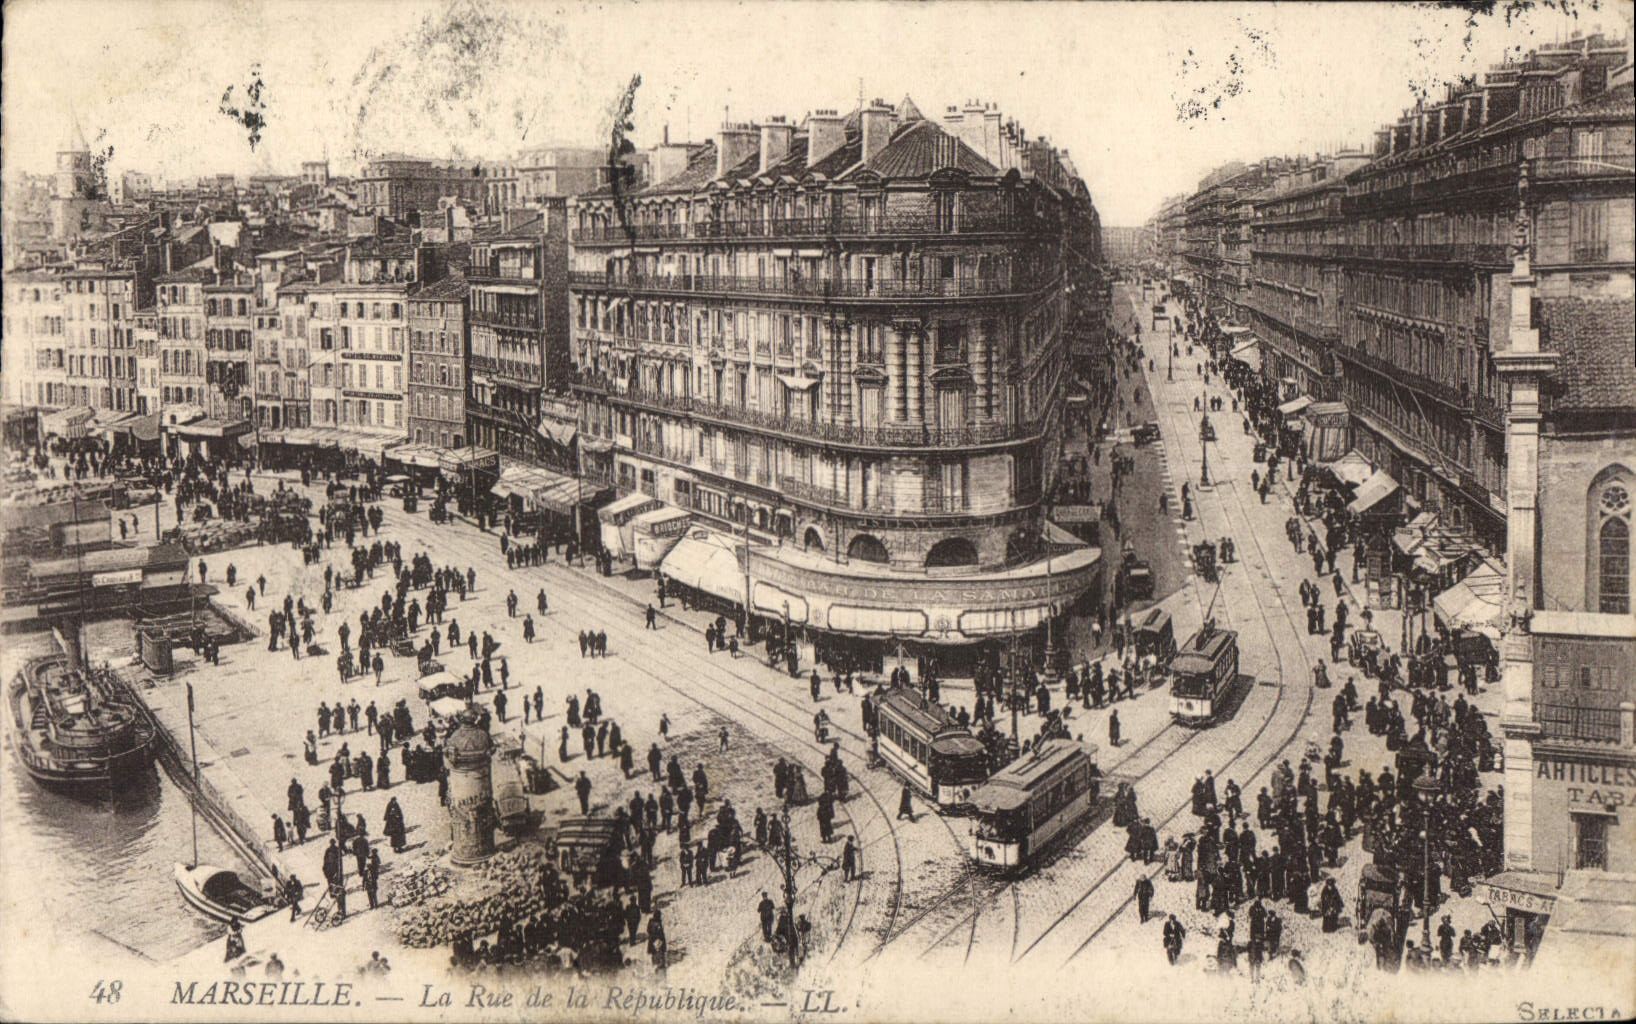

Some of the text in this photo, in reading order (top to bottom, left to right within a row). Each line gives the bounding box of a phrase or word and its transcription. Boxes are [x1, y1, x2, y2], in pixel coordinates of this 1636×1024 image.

[864, 587, 896, 600] DE
[912, 590, 947, 601] LA
[1488, 888, 1534, 909] TABACS
